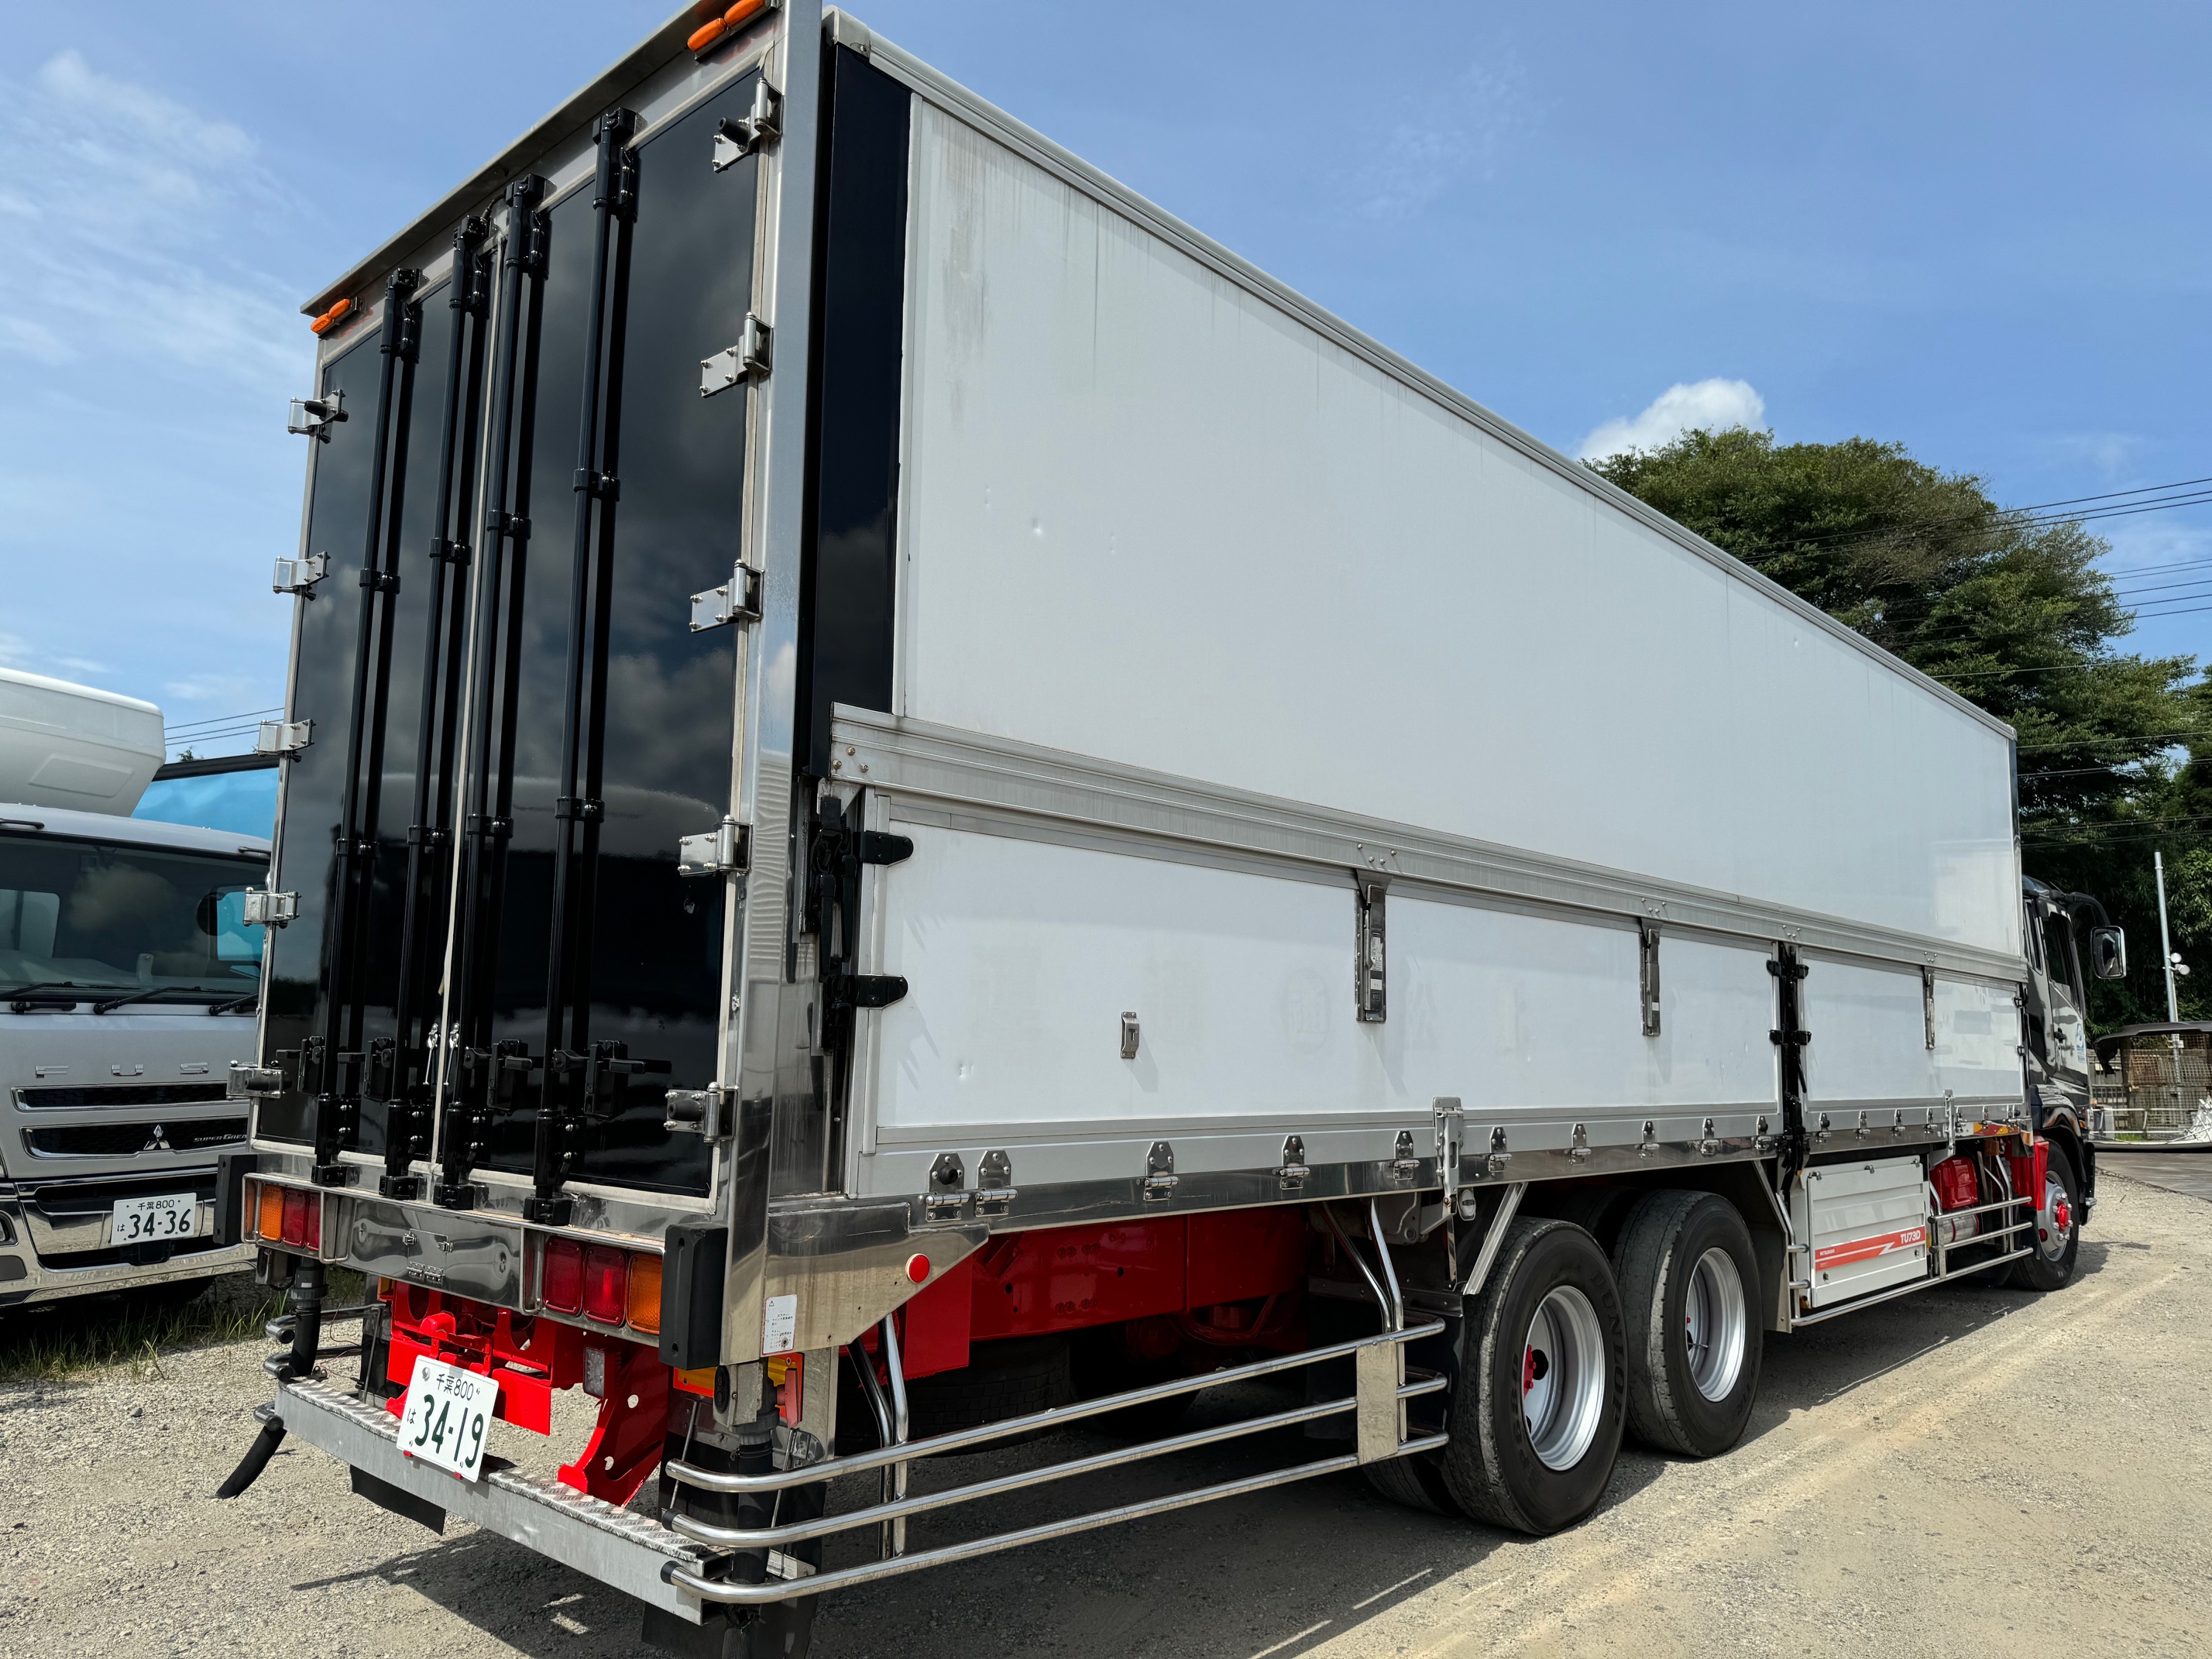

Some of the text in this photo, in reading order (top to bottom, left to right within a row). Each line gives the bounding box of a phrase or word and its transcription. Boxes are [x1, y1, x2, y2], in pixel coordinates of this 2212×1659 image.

[117, 1208, 191, 1238] は 34-36
[1900, 1230, 1921, 1244] TU73D
[1590, 1270, 1624, 1426] DUNLOP
[407, 1394, 484, 1468] は 34-19
